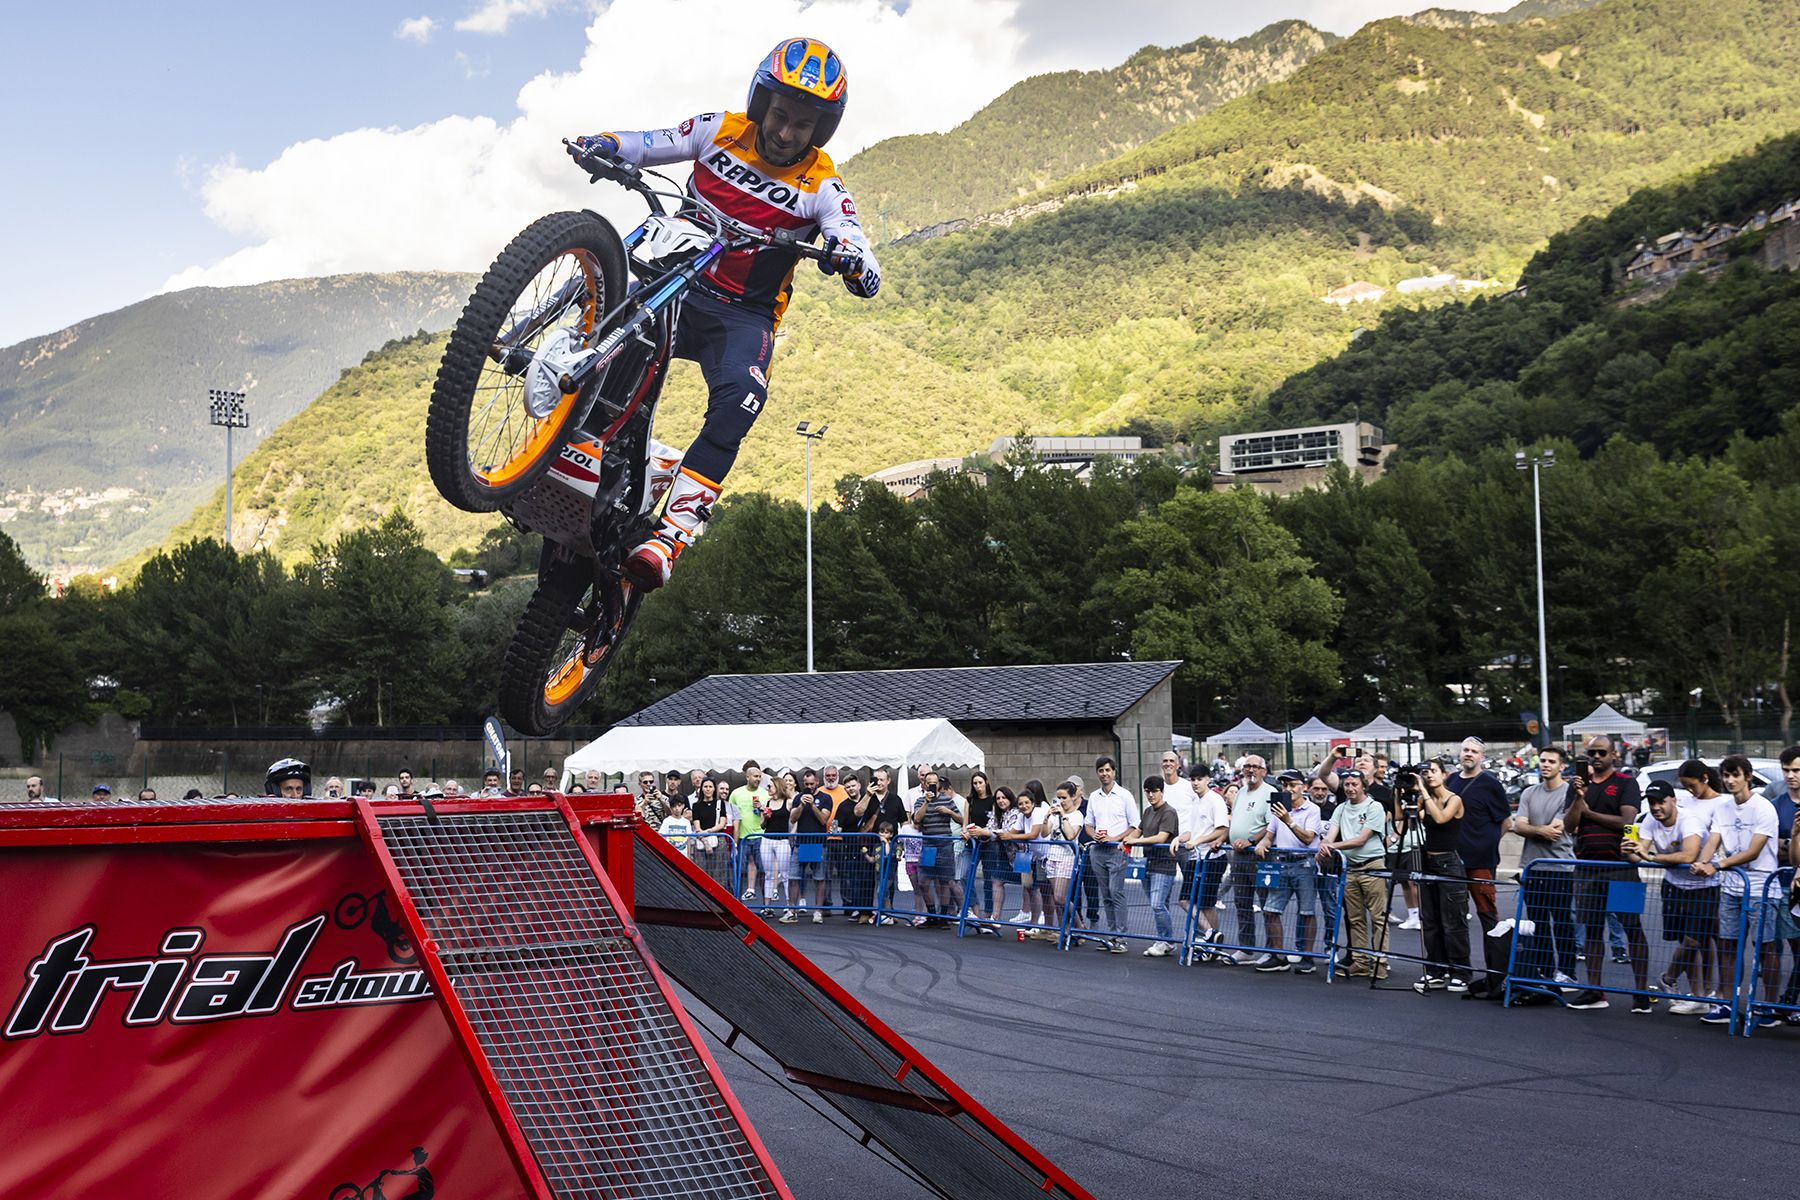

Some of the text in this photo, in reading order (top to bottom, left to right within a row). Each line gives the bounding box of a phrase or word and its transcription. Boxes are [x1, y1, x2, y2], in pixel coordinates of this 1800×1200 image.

[707, 151, 800, 211] REPSOL
[561, 446, 593, 469] PSOL
[4, 913, 435, 1038] trial show
